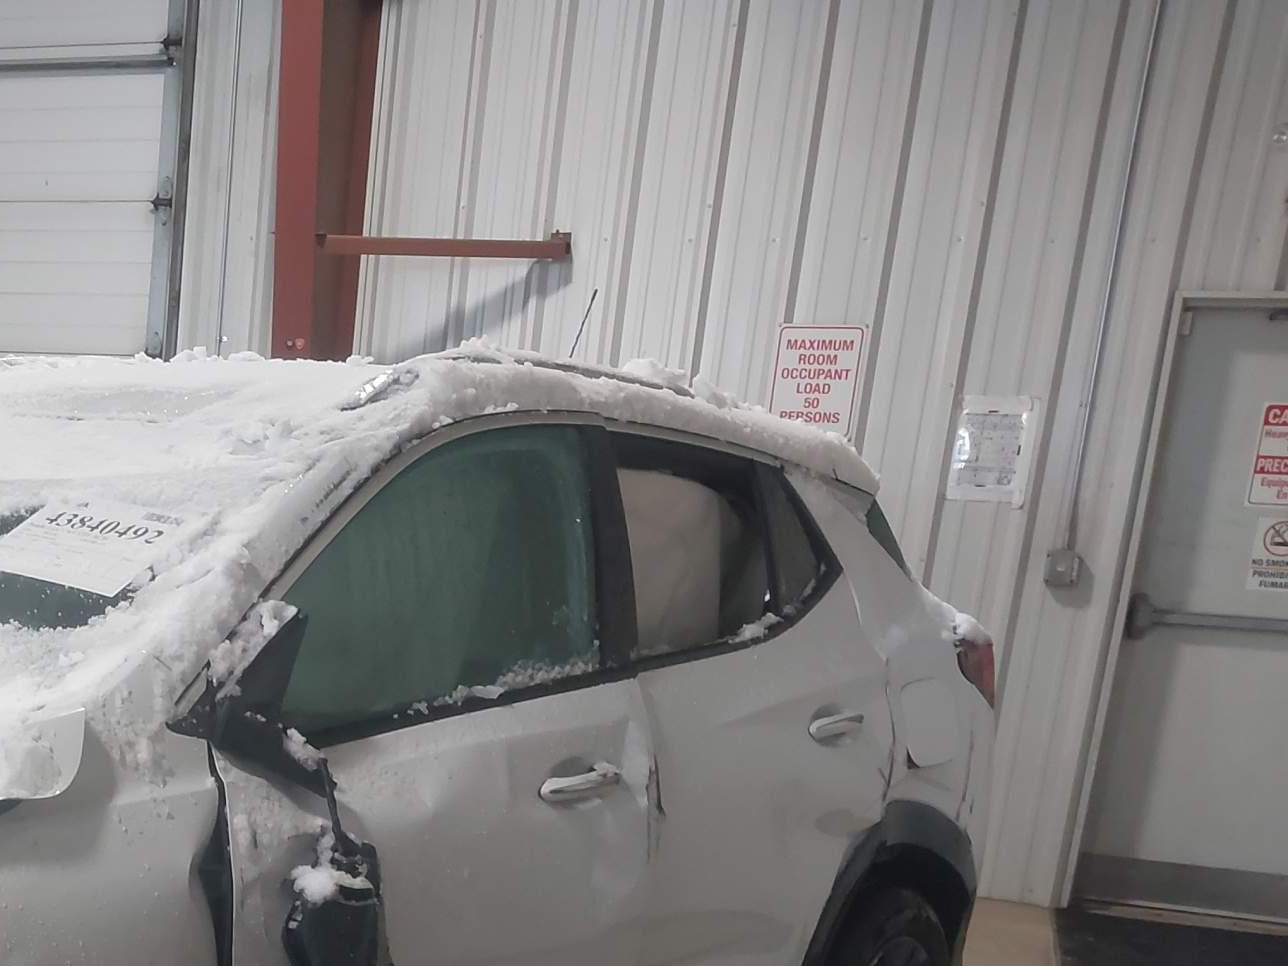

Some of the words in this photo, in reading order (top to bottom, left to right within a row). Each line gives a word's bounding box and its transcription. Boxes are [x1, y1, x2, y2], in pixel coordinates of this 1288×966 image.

[786, 339, 854, 351] MAXIMUM
[798, 354, 838, 365] ROOM
[781, 368, 851, 380] OCCUPANT
[796, 383, 831, 394] LOAD
[803, 398, 820, 409] 50
[779, 411, 840, 424] PERSONS
[46, 512, 164, 544] 43840492
